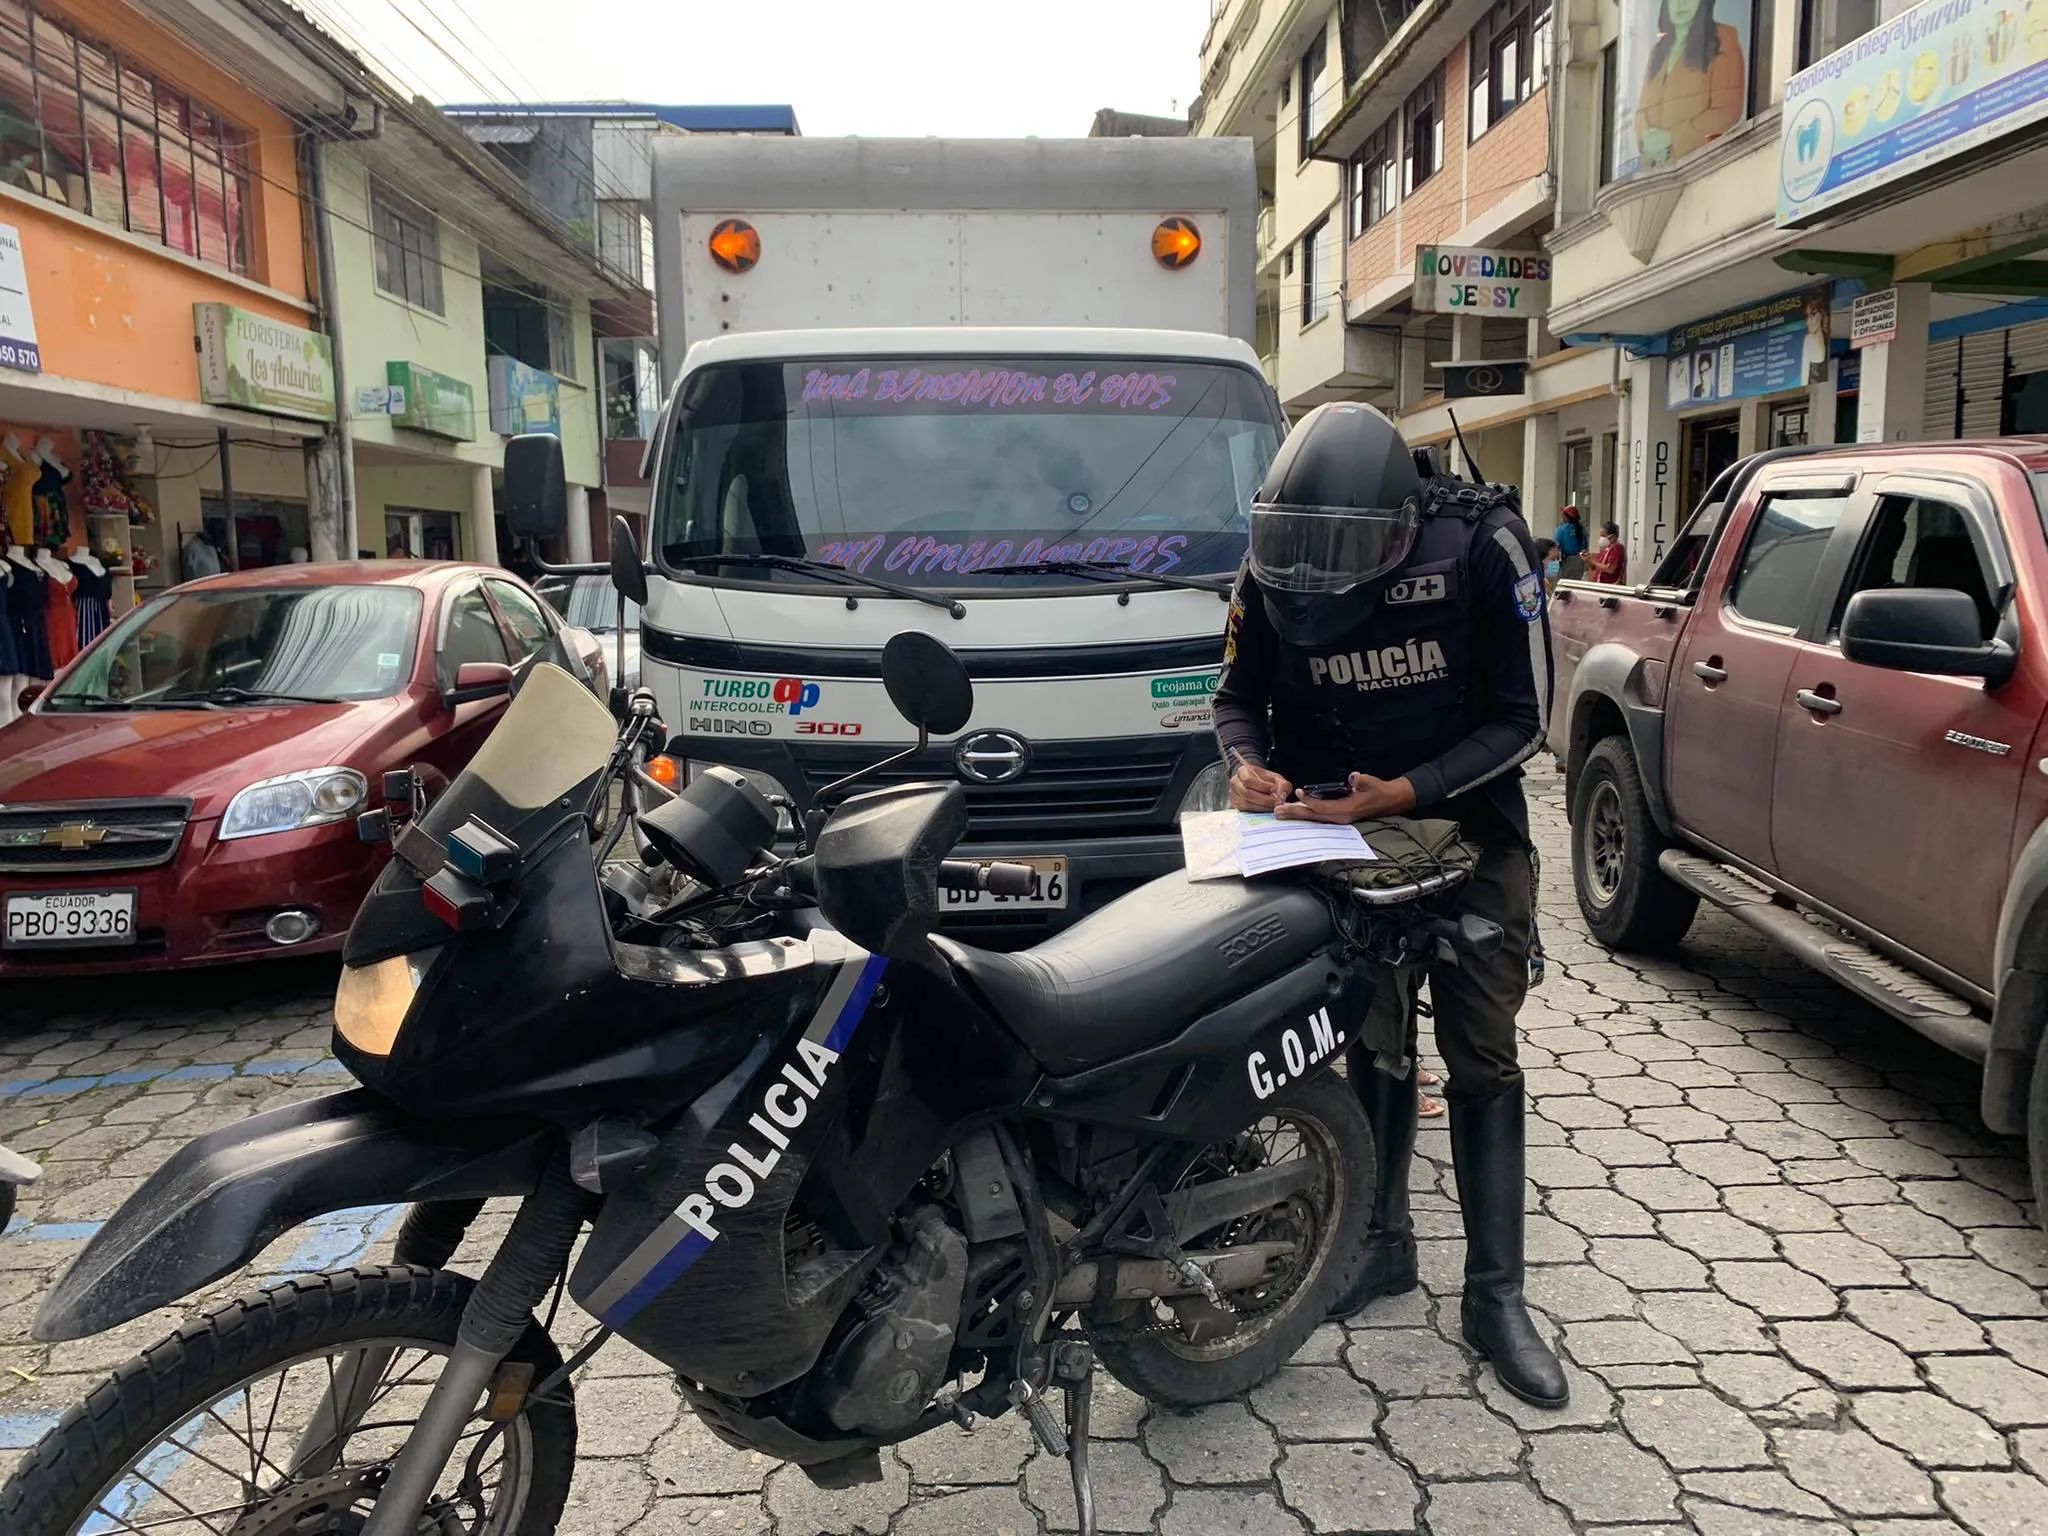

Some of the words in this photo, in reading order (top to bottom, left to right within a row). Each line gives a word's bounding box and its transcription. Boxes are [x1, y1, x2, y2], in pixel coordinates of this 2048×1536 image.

[0, 235, 18, 251] NAL
[1423, 251, 1550, 281] NOVEDADES
[1449, 284, 1520, 308] JESSY
[0, 314, 12, 326] AL
[1686, 320, 1714, 339] CENTRO
[1768, 296, 1801, 317] VARGAS
[1854, 317, 1871, 328] CON
[1859, 321, 1895, 337] OFICINAS
[0, 344, 15, 362] 50
[18, 349, 38, 367] 570
[247, 348, 269, 389] Los
[270, 354, 323, 394] Anturios
[803, 367, 870, 401] UNA
[876, 369, 1046, 408] BENDICION
[1053, 371, 1097, 405] DE
[1100, 372, 1177, 410] DIOS
[1653, 440, 1669, 564] OPTICA
[884, 535, 1014, 575] CINCO
[1014, 534, 1188, 575] AMORES
[1308, 638, 1448, 685] POLICÍA
[703, 679, 771, 698] TURBO
[1154, 680, 1203, 694] Teojama
[1357, 669, 1448, 692] NACIONAL
[689, 700, 785, 714] INTERCOOLER
[689, 717, 772, 735] HINO
[794, 721, 862, 736] 300
[45, 896, 96, 908] ECUADOR
[9, 909, 129, 937] PBO-9336
[1247, 1006, 1346, 1100] G.O.M.
[673, 1037, 840, 1242] POLICIA
